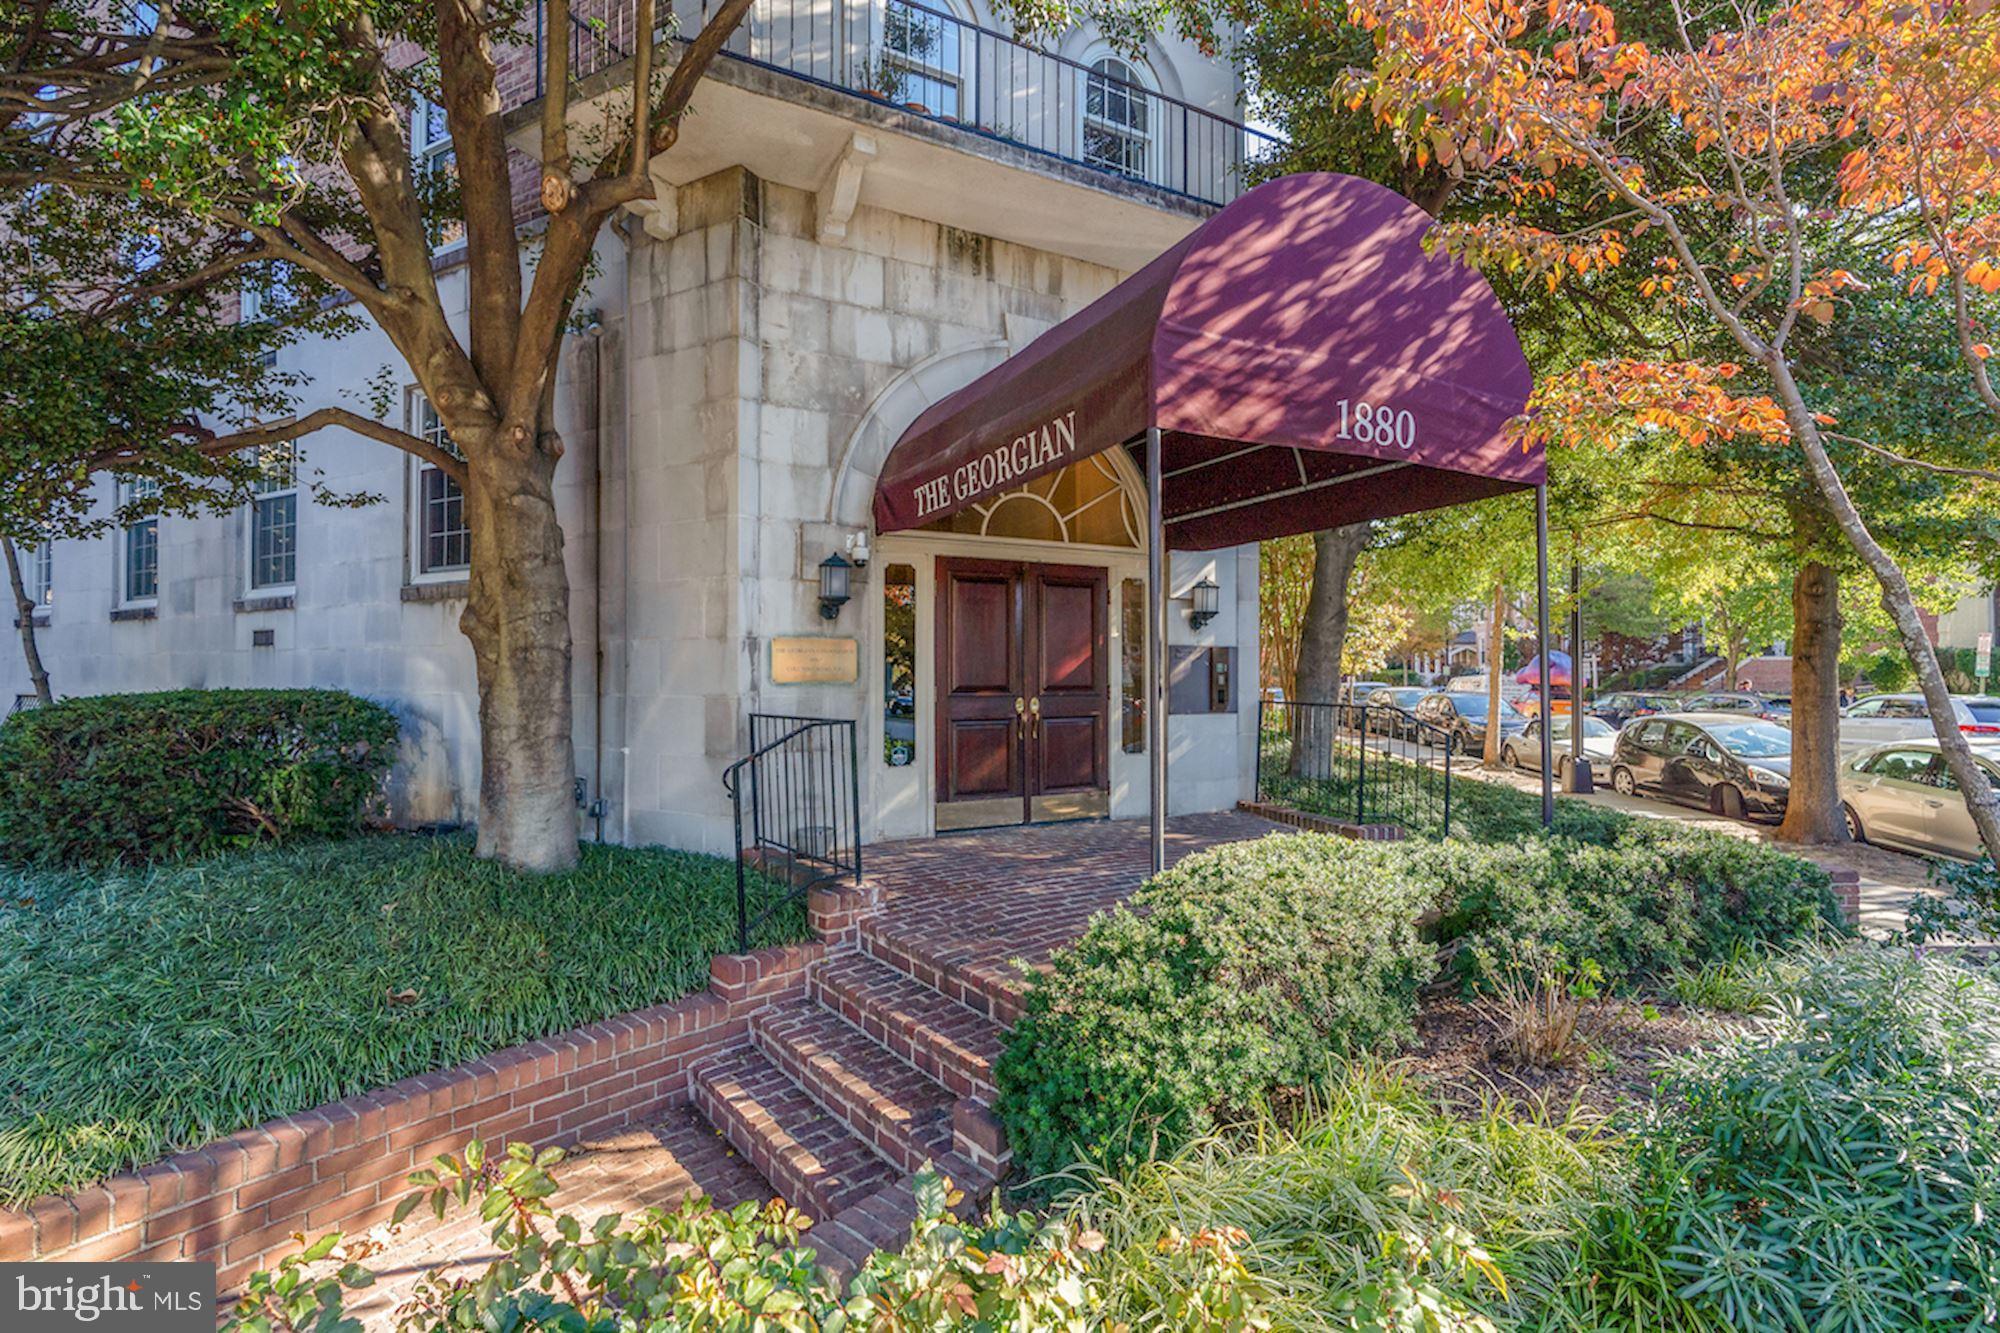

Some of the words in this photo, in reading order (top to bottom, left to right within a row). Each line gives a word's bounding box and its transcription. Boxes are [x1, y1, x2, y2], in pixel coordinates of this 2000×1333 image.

[1336, 399, 1416, 449] 1880
[913, 475, 950, 517] THE
[953, 411, 1075, 501] GEORGIAN
